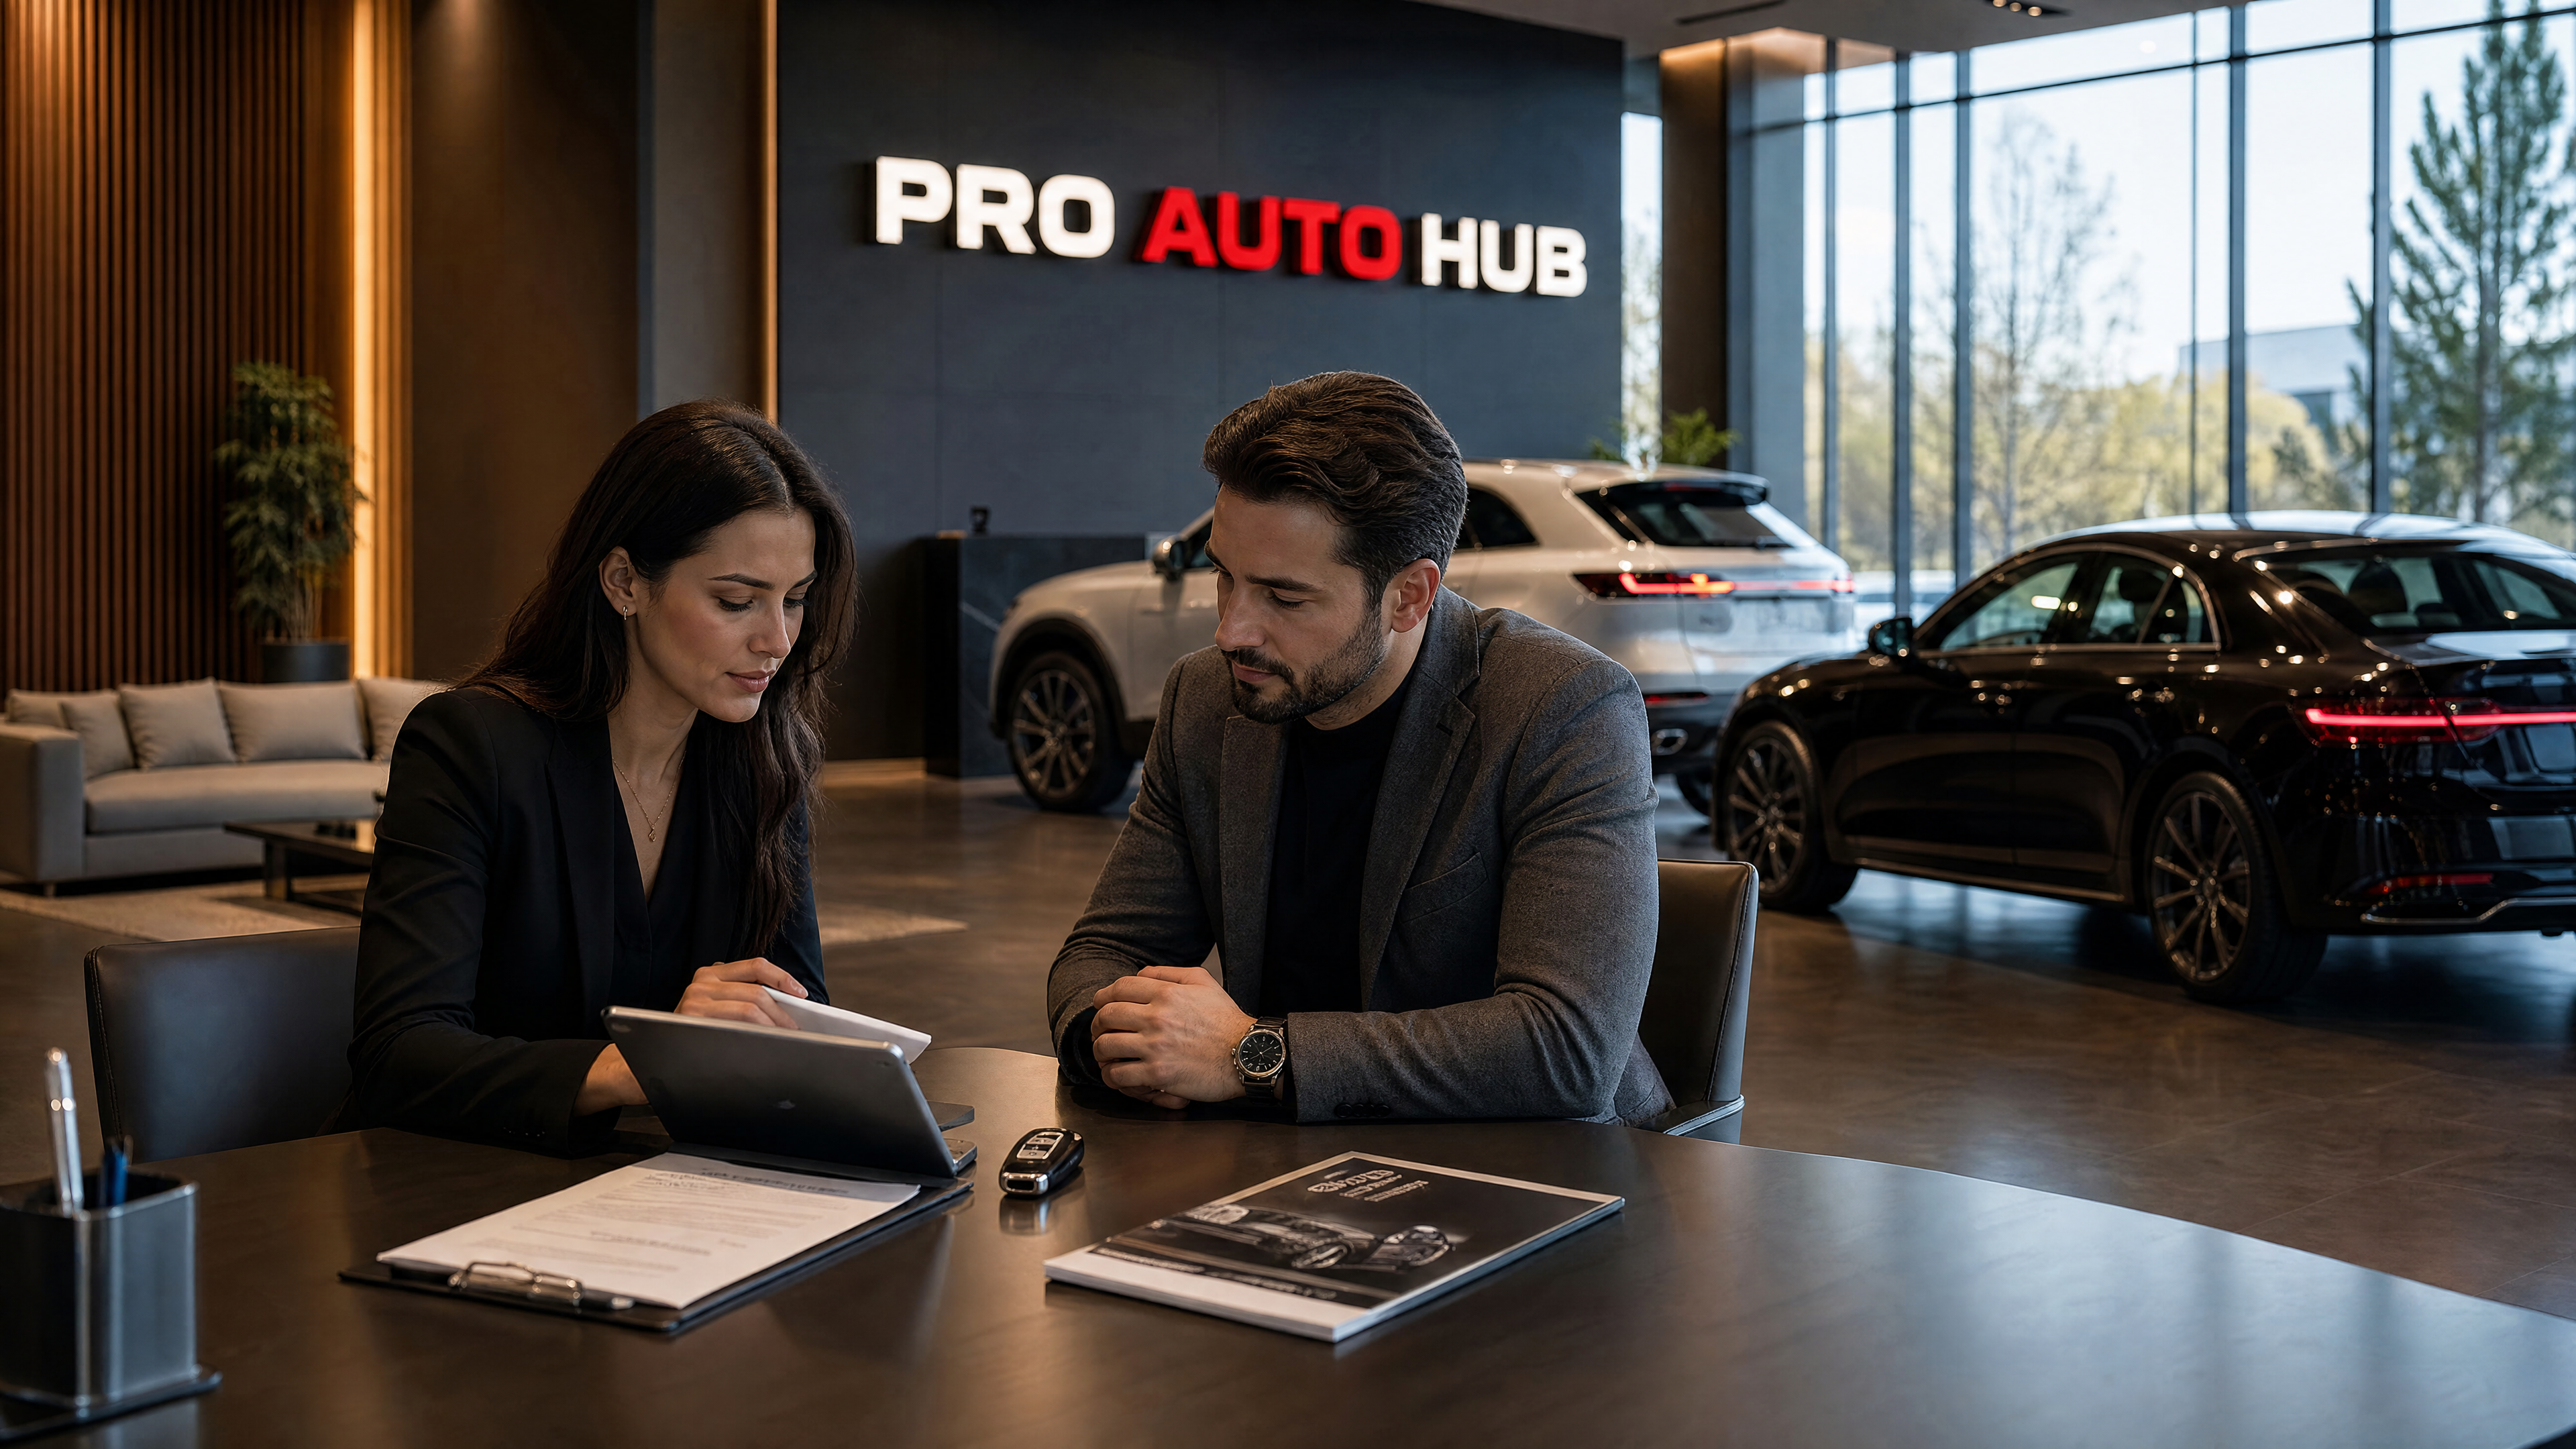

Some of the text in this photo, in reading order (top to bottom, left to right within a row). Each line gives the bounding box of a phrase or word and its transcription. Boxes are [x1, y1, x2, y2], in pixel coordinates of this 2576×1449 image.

[875, 156, 1587, 297] PRO AUTO HUB
